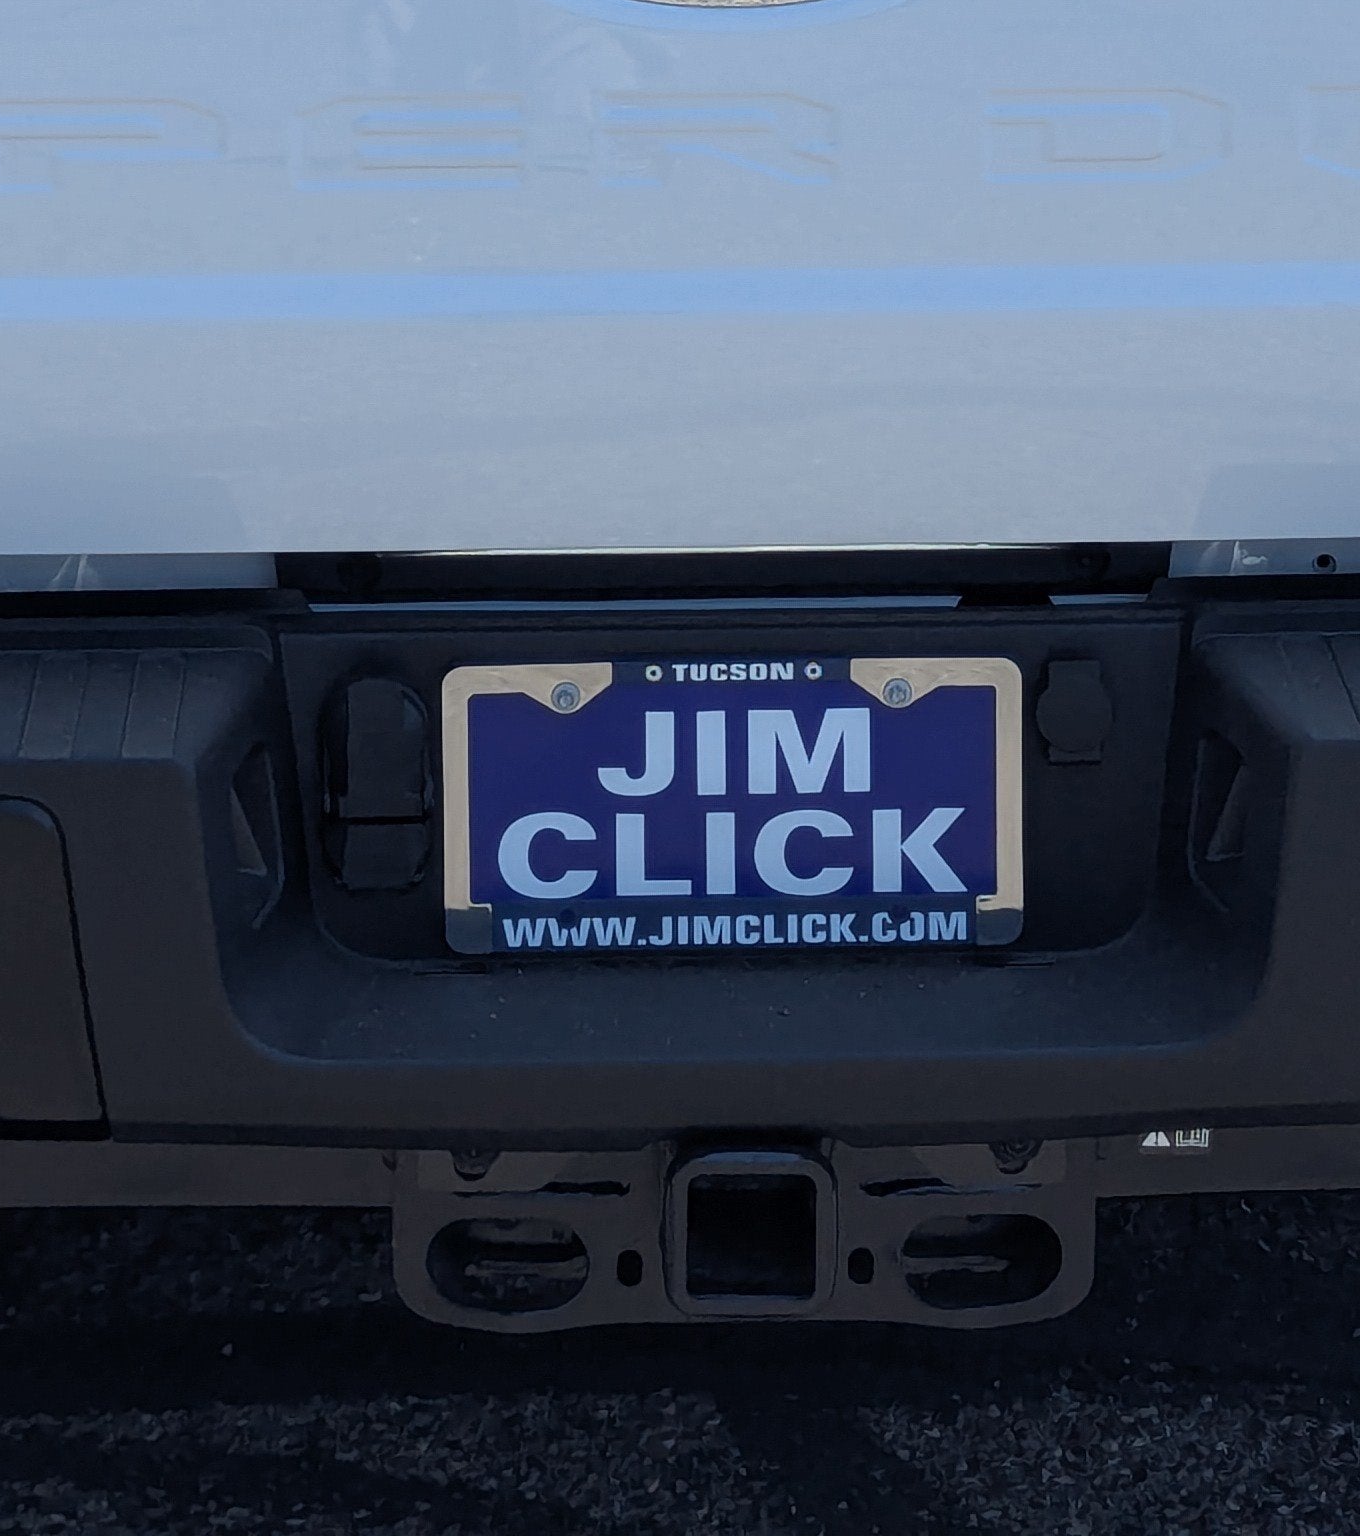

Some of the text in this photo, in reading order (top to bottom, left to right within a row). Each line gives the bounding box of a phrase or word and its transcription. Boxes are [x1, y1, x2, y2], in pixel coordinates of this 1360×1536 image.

[671, 662, 795, 682] TUCSON
[597, 707, 871, 797] JIM
[497, 807, 968, 899] CLICK
[502, 910, 969, 948] WWW.JIMCLICK.COM
